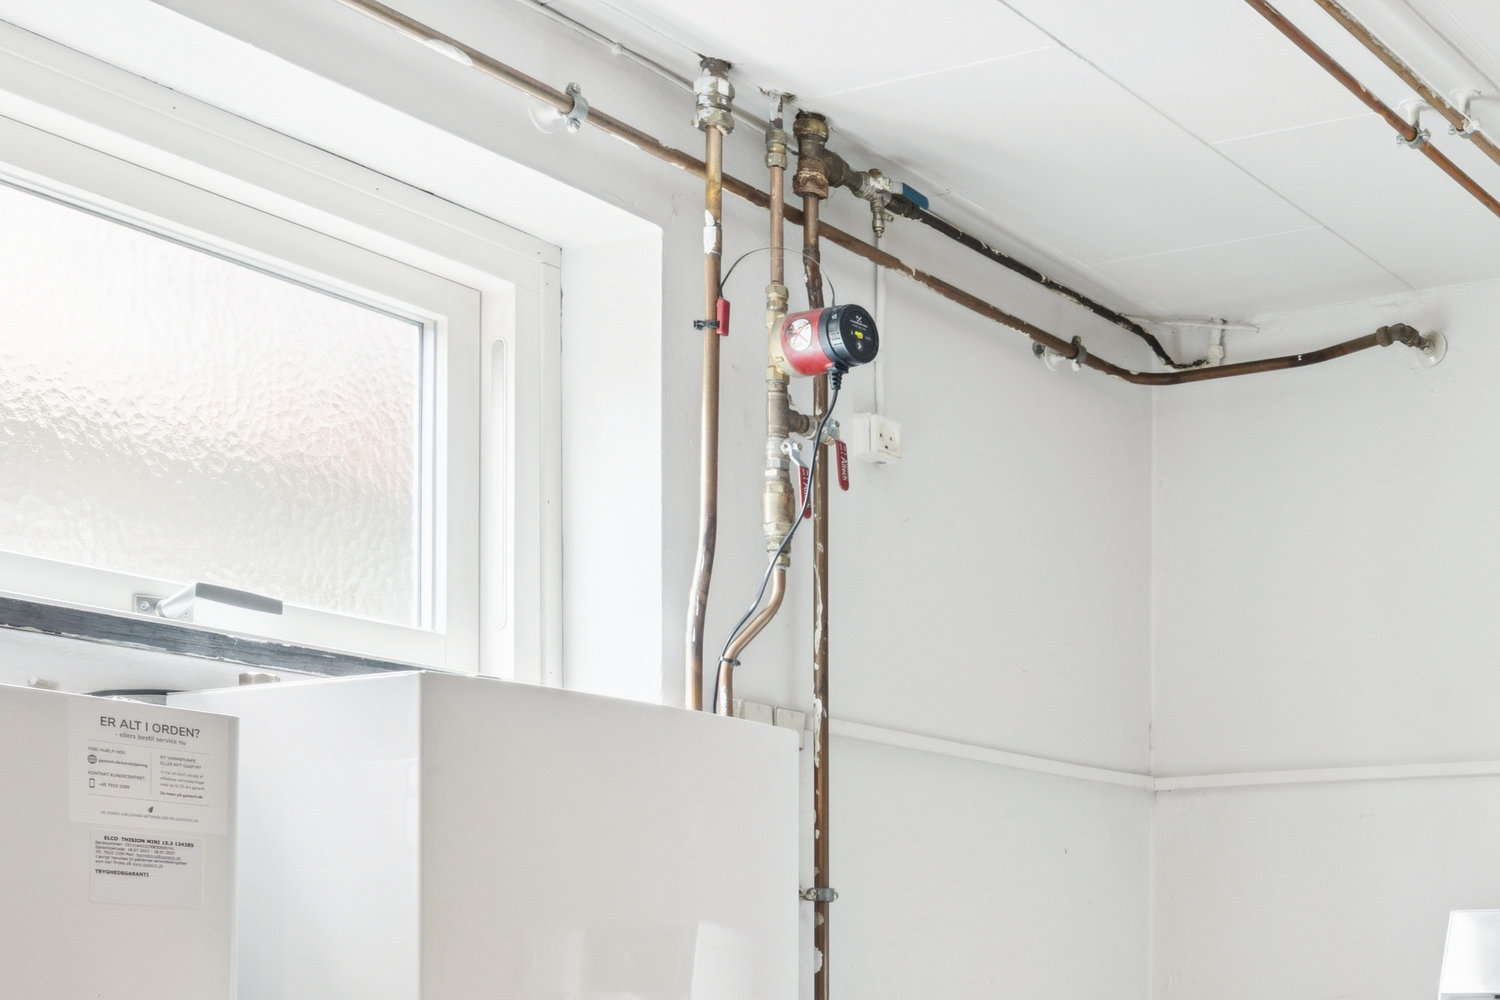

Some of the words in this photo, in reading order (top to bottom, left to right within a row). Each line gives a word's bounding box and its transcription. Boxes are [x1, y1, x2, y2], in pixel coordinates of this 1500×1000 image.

[100, 716, 116, 728] ER
[120, 719, 142, 731] ALT
[152, 723, 200, 738] ORDEN?
[119, 732, 136, 740] ellers
